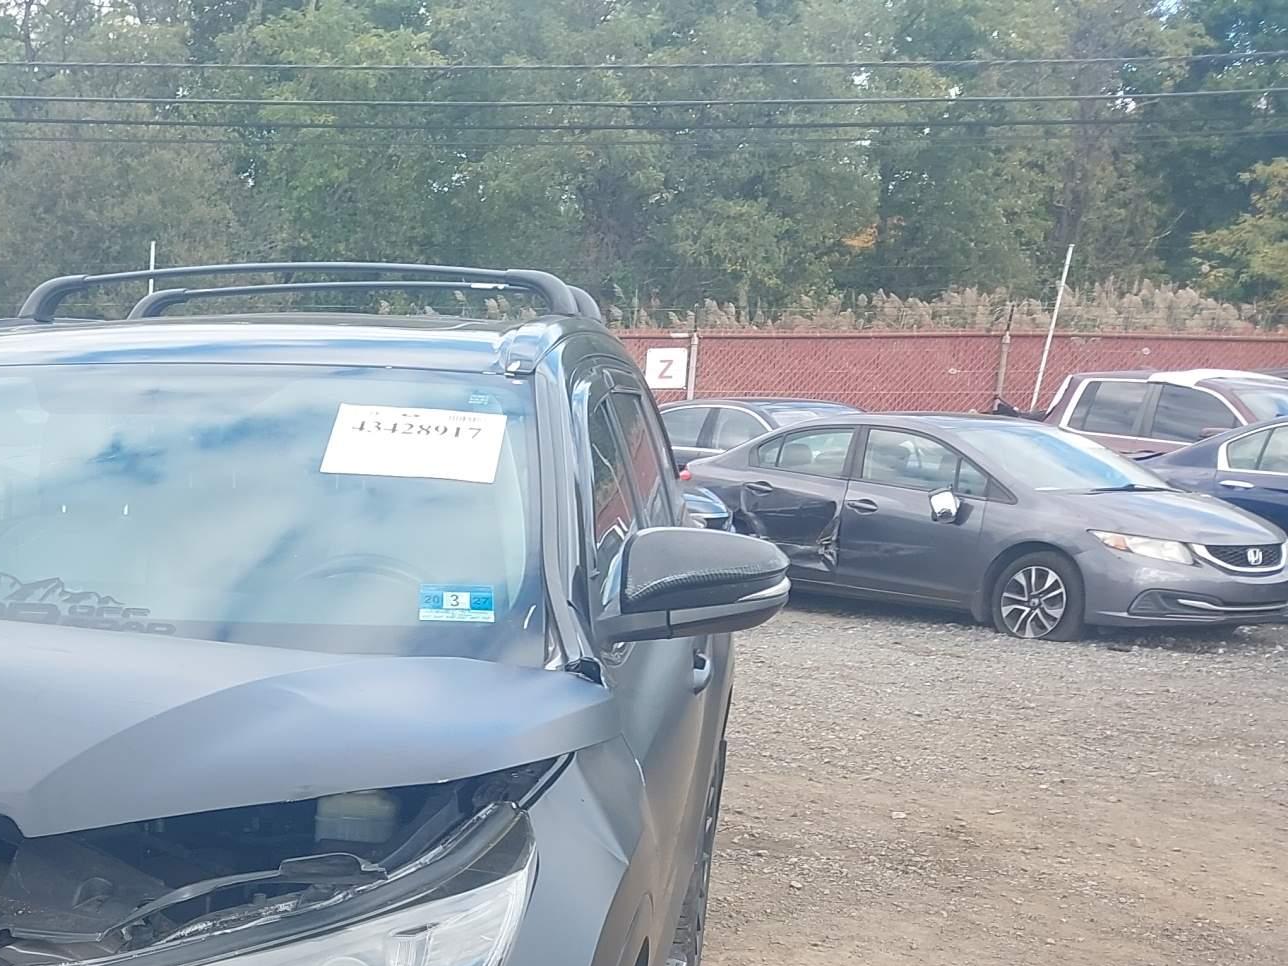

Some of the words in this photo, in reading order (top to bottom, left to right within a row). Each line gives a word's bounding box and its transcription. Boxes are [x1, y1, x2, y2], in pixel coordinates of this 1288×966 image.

[658, 359, 674, 380] Z
[351, 420, 483, 440] 43428917
[423, 594, 441, 605] 20
[449, 593, 460, 607] 3
[472, 596, 490, 606] 27
